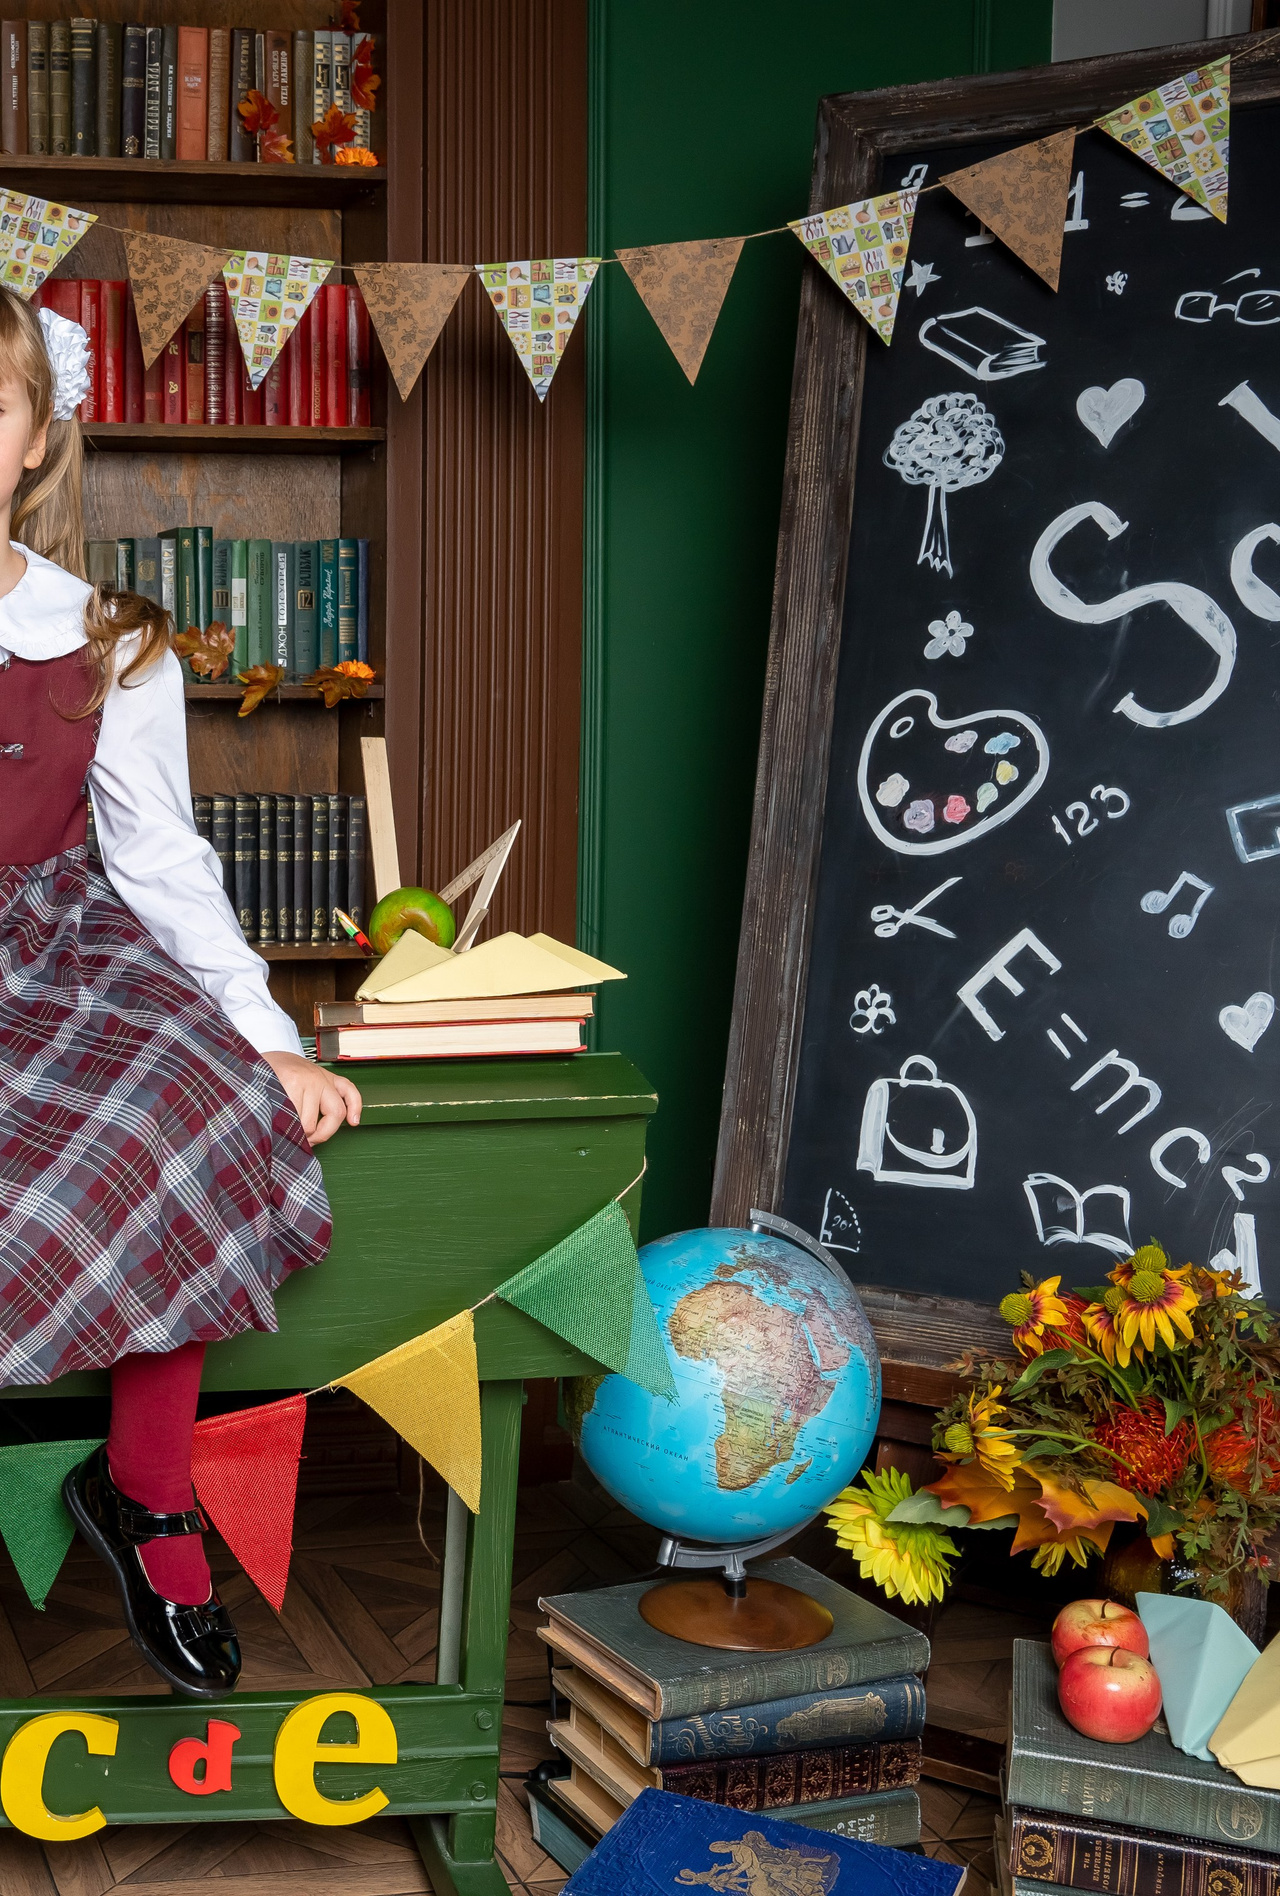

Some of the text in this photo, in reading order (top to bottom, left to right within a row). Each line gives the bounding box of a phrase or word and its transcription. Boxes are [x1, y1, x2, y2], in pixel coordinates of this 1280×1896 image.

[237, 35, 251, 91] Кристи
[215, 548, 227, 586] БАЛЬЗАК
[299, 548, 312, 587] БАЛЬЗАК
[278, 554, 288, 657] ДЖОН ГОЛСУОРСИ
[300, 592, 313, 608] 12
[1050, 784, 1131, 847] 123
[602, 1424, 689, 1462] АТЛАНТИЧЕСКИЙ ОКЕАН
[0, 1711, 120, 1842] c
[167, 1718, 243, 1796] d
[272, 1691, 399, 1827] e
[1083, 1852, 1091, 1870] THE
[1092, 1840, 1103, 1882] EMPRESS
[1155, 1852, 1165, 1895] TURQUAN
